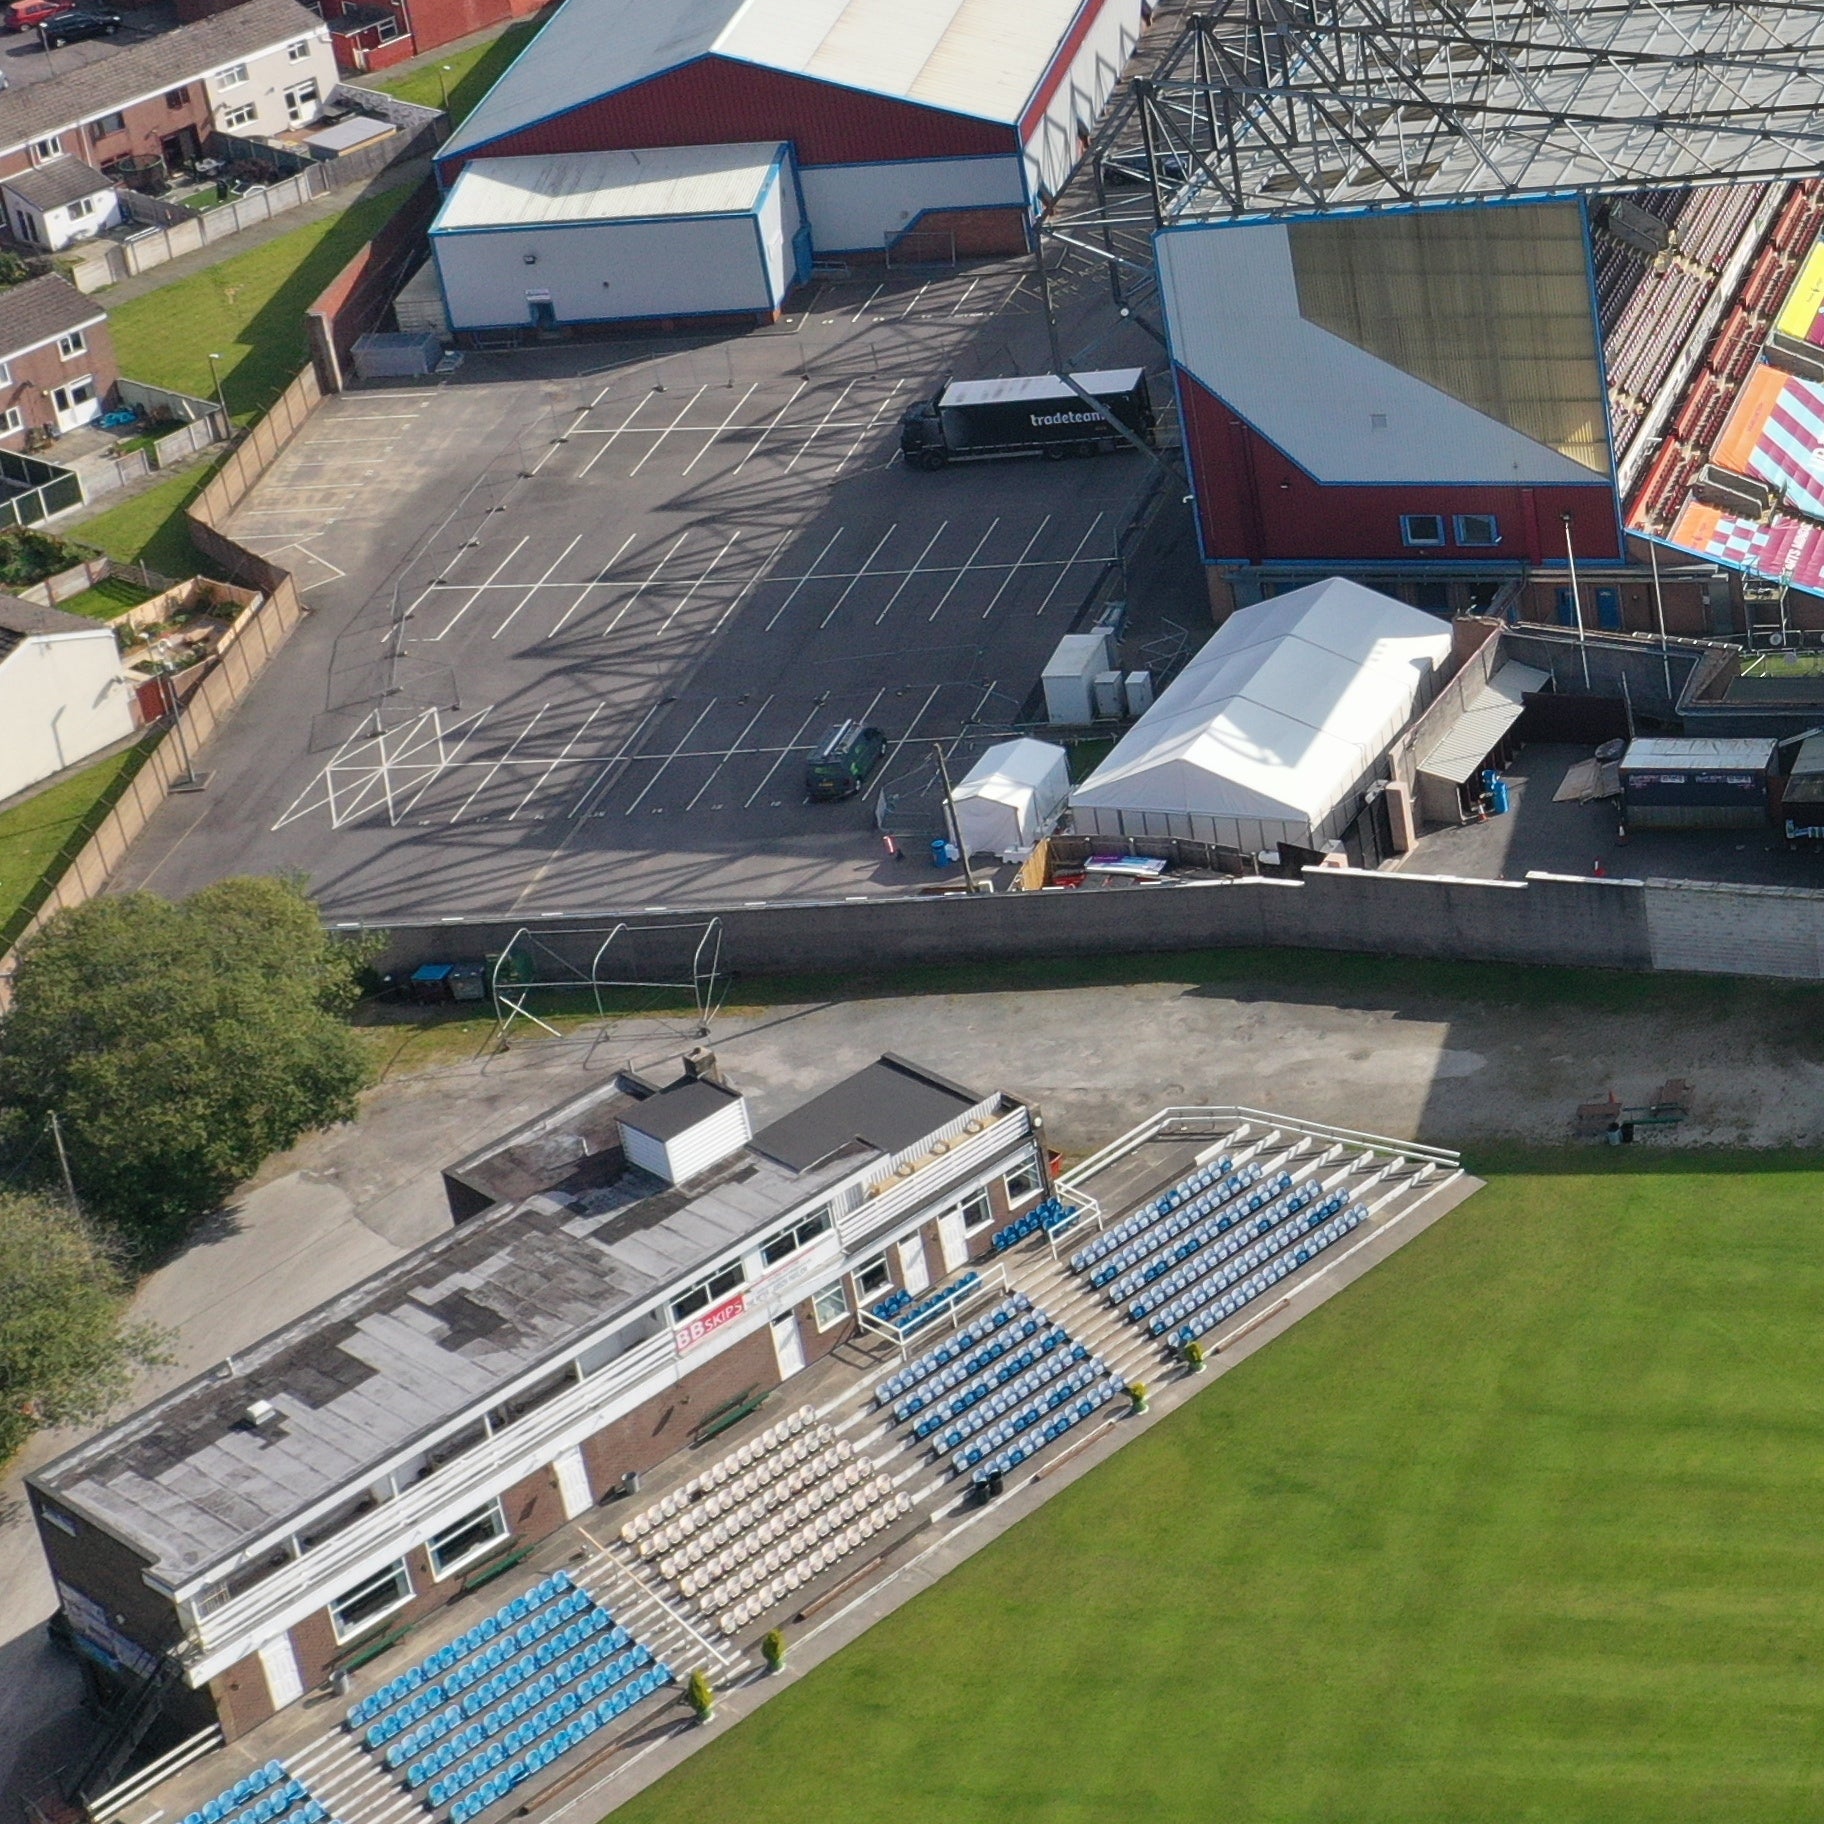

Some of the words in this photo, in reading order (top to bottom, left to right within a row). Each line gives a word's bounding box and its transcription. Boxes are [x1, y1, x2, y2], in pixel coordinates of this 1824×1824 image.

[1030, 410, 1105, 427] tradeteam
[1796, 522, 1814, 551] MINDS
[675, 1320, 705, 1350] BB
[704, 1302, 743, 1331] SKIPS
